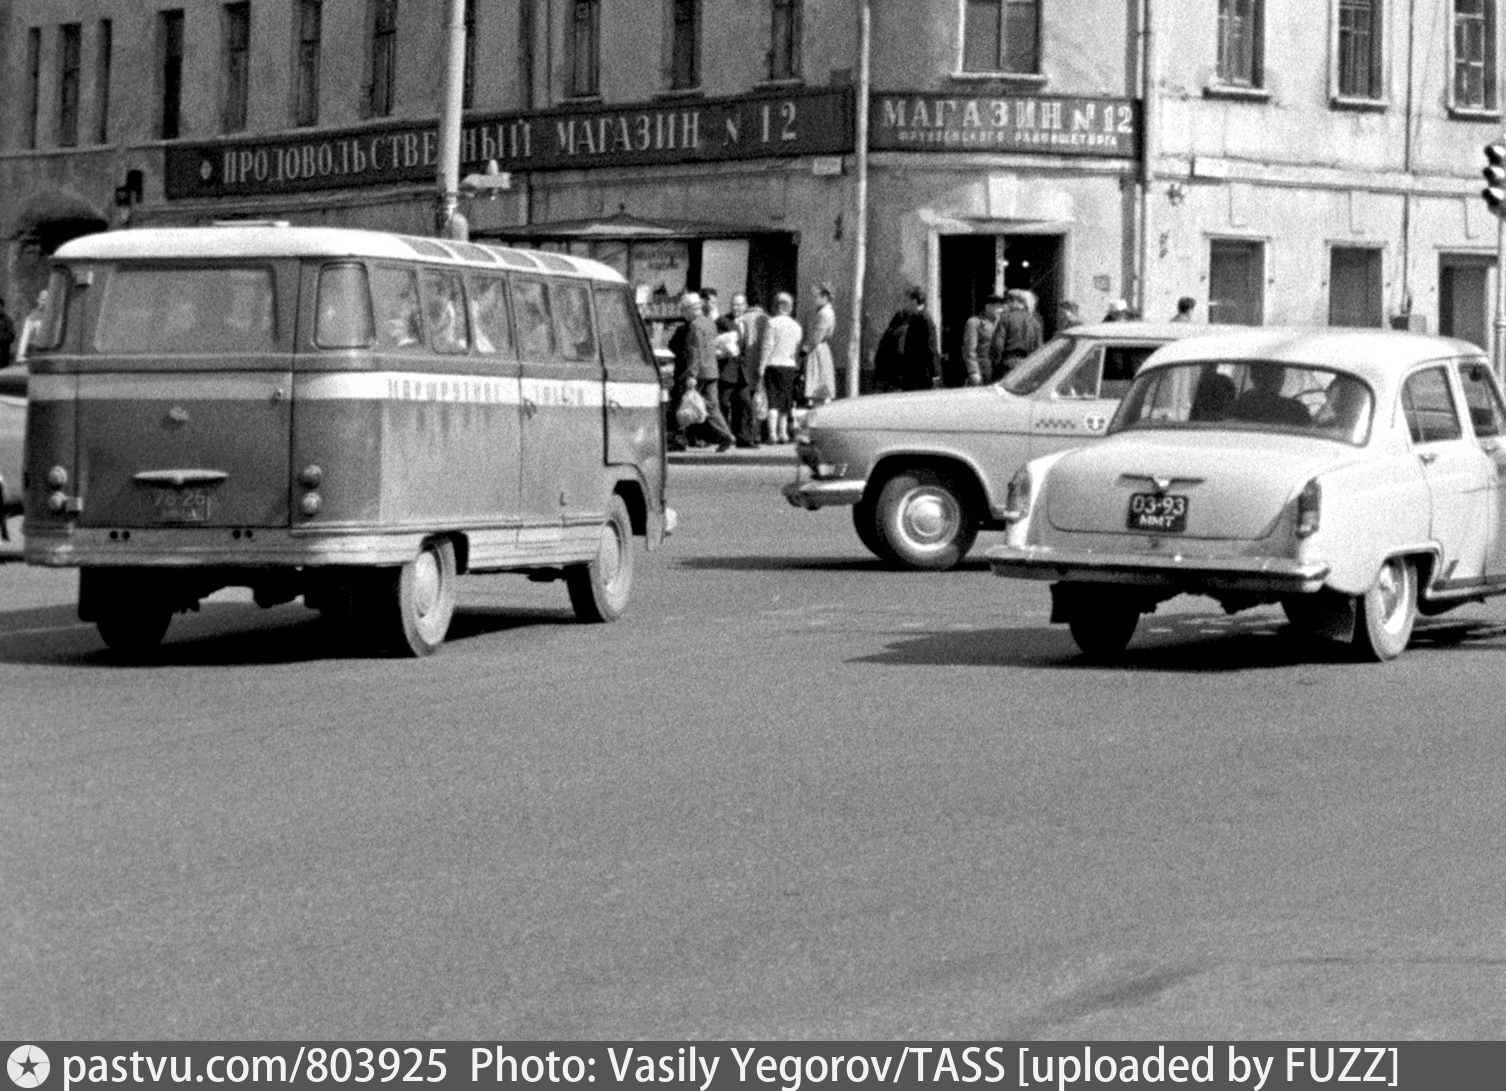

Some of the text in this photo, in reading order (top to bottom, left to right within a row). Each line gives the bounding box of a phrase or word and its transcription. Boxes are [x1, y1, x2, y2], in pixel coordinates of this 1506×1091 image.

[883, 99, 1062, 130] МАГАЗИН
[1102, 105, 1133, 134] 12
[223, 119, 531, 184] ПРОДОВОЛЬСТВЕНЫЙ
[556, 113, 700, 156] МАГАЗИН
[760, 101, 797, 143] 12
[1133, 495, 1185, 515] 03-93
